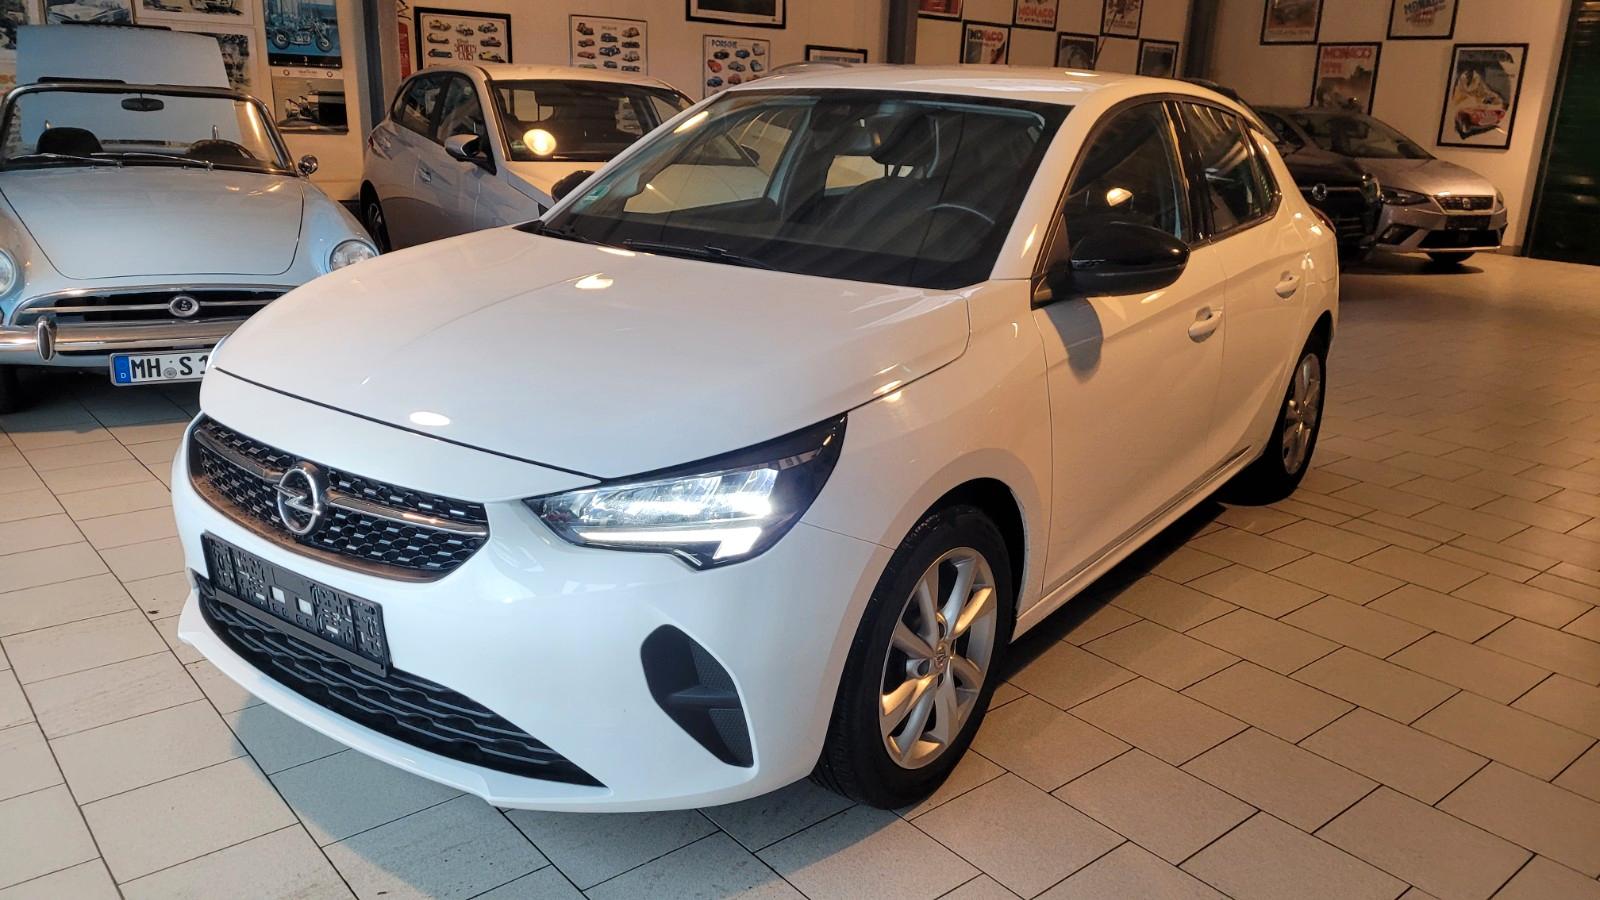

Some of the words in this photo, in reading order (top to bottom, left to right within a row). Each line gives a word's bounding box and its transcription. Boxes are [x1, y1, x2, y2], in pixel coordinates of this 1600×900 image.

[967, 28, 1004, 42] MONACO
[711, 39, 737, 48] PORSCHE
[1321, 47, 1372, 59] MONACO
[131, 358, 161, 378] MH
[179, 356, 193, 376] S
